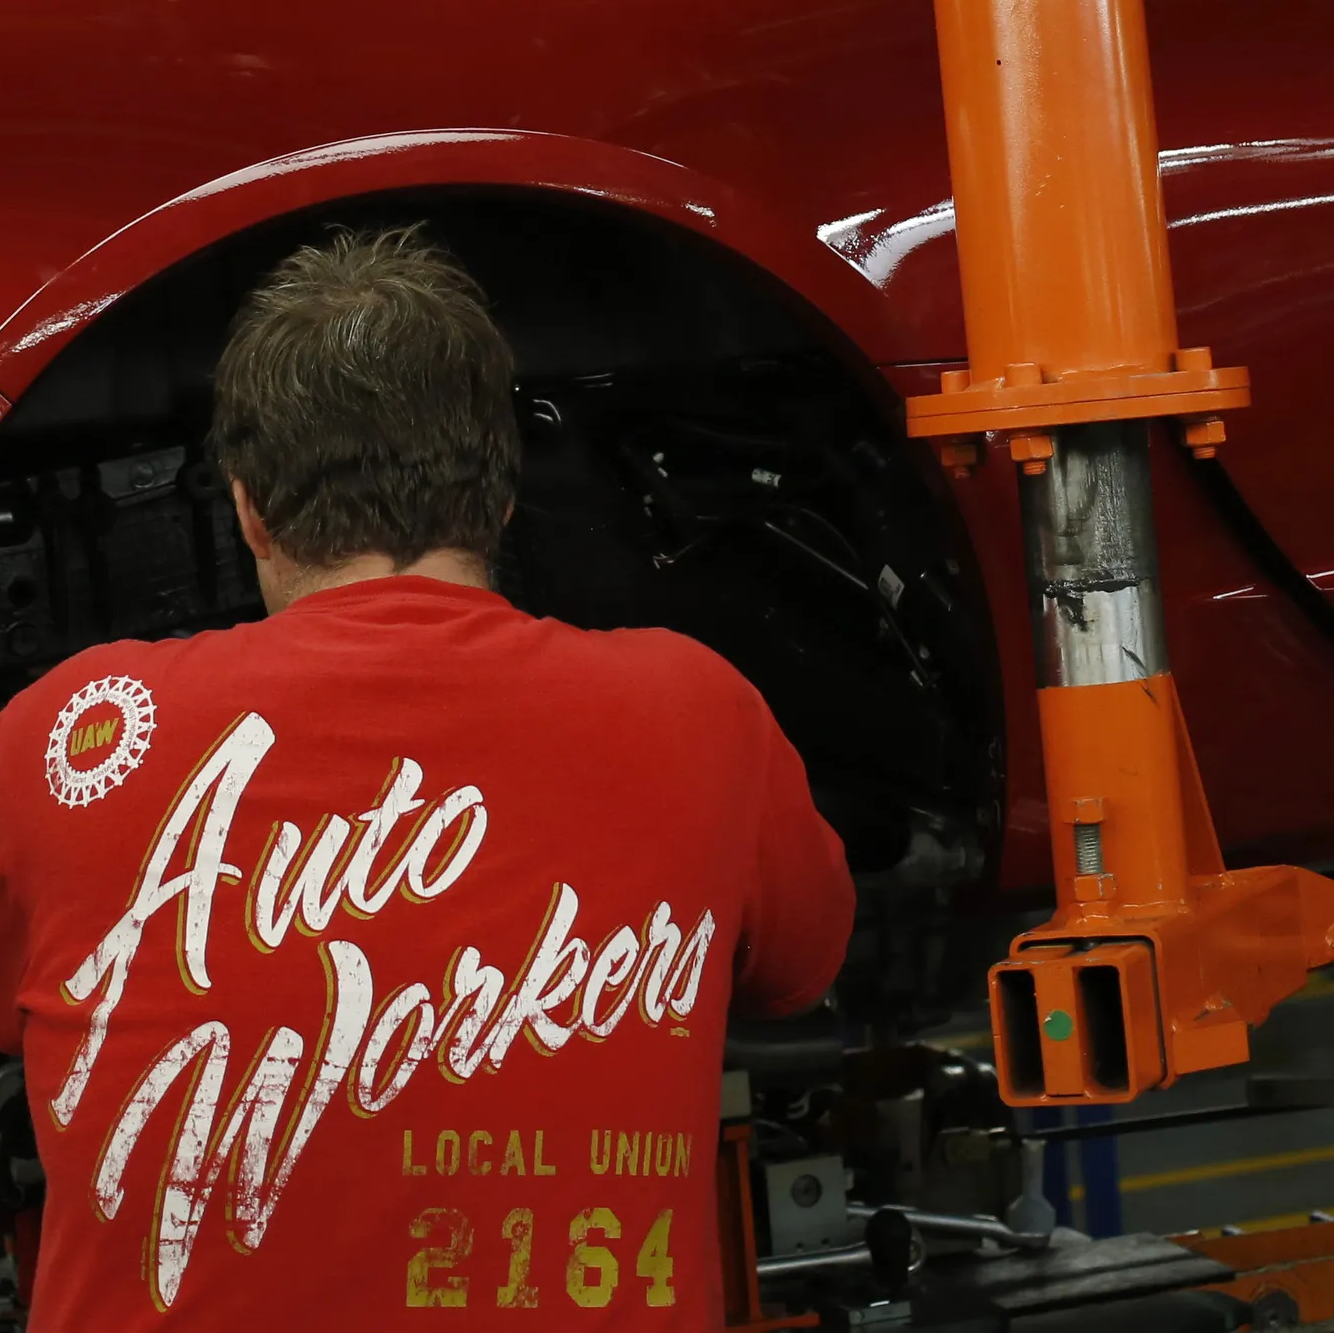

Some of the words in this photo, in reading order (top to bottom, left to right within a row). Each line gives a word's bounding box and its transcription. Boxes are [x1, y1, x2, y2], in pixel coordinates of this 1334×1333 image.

[70, 717, 120, 757] UAW
[49, 710, 488, 1131] Auto
[89, 881, 717, 1312] Workers
[402, 1129, 558, 1178] LOCAL
[590, 1129, 692, 1179] UNION
[405, 1206, 677, 1309] 2164
